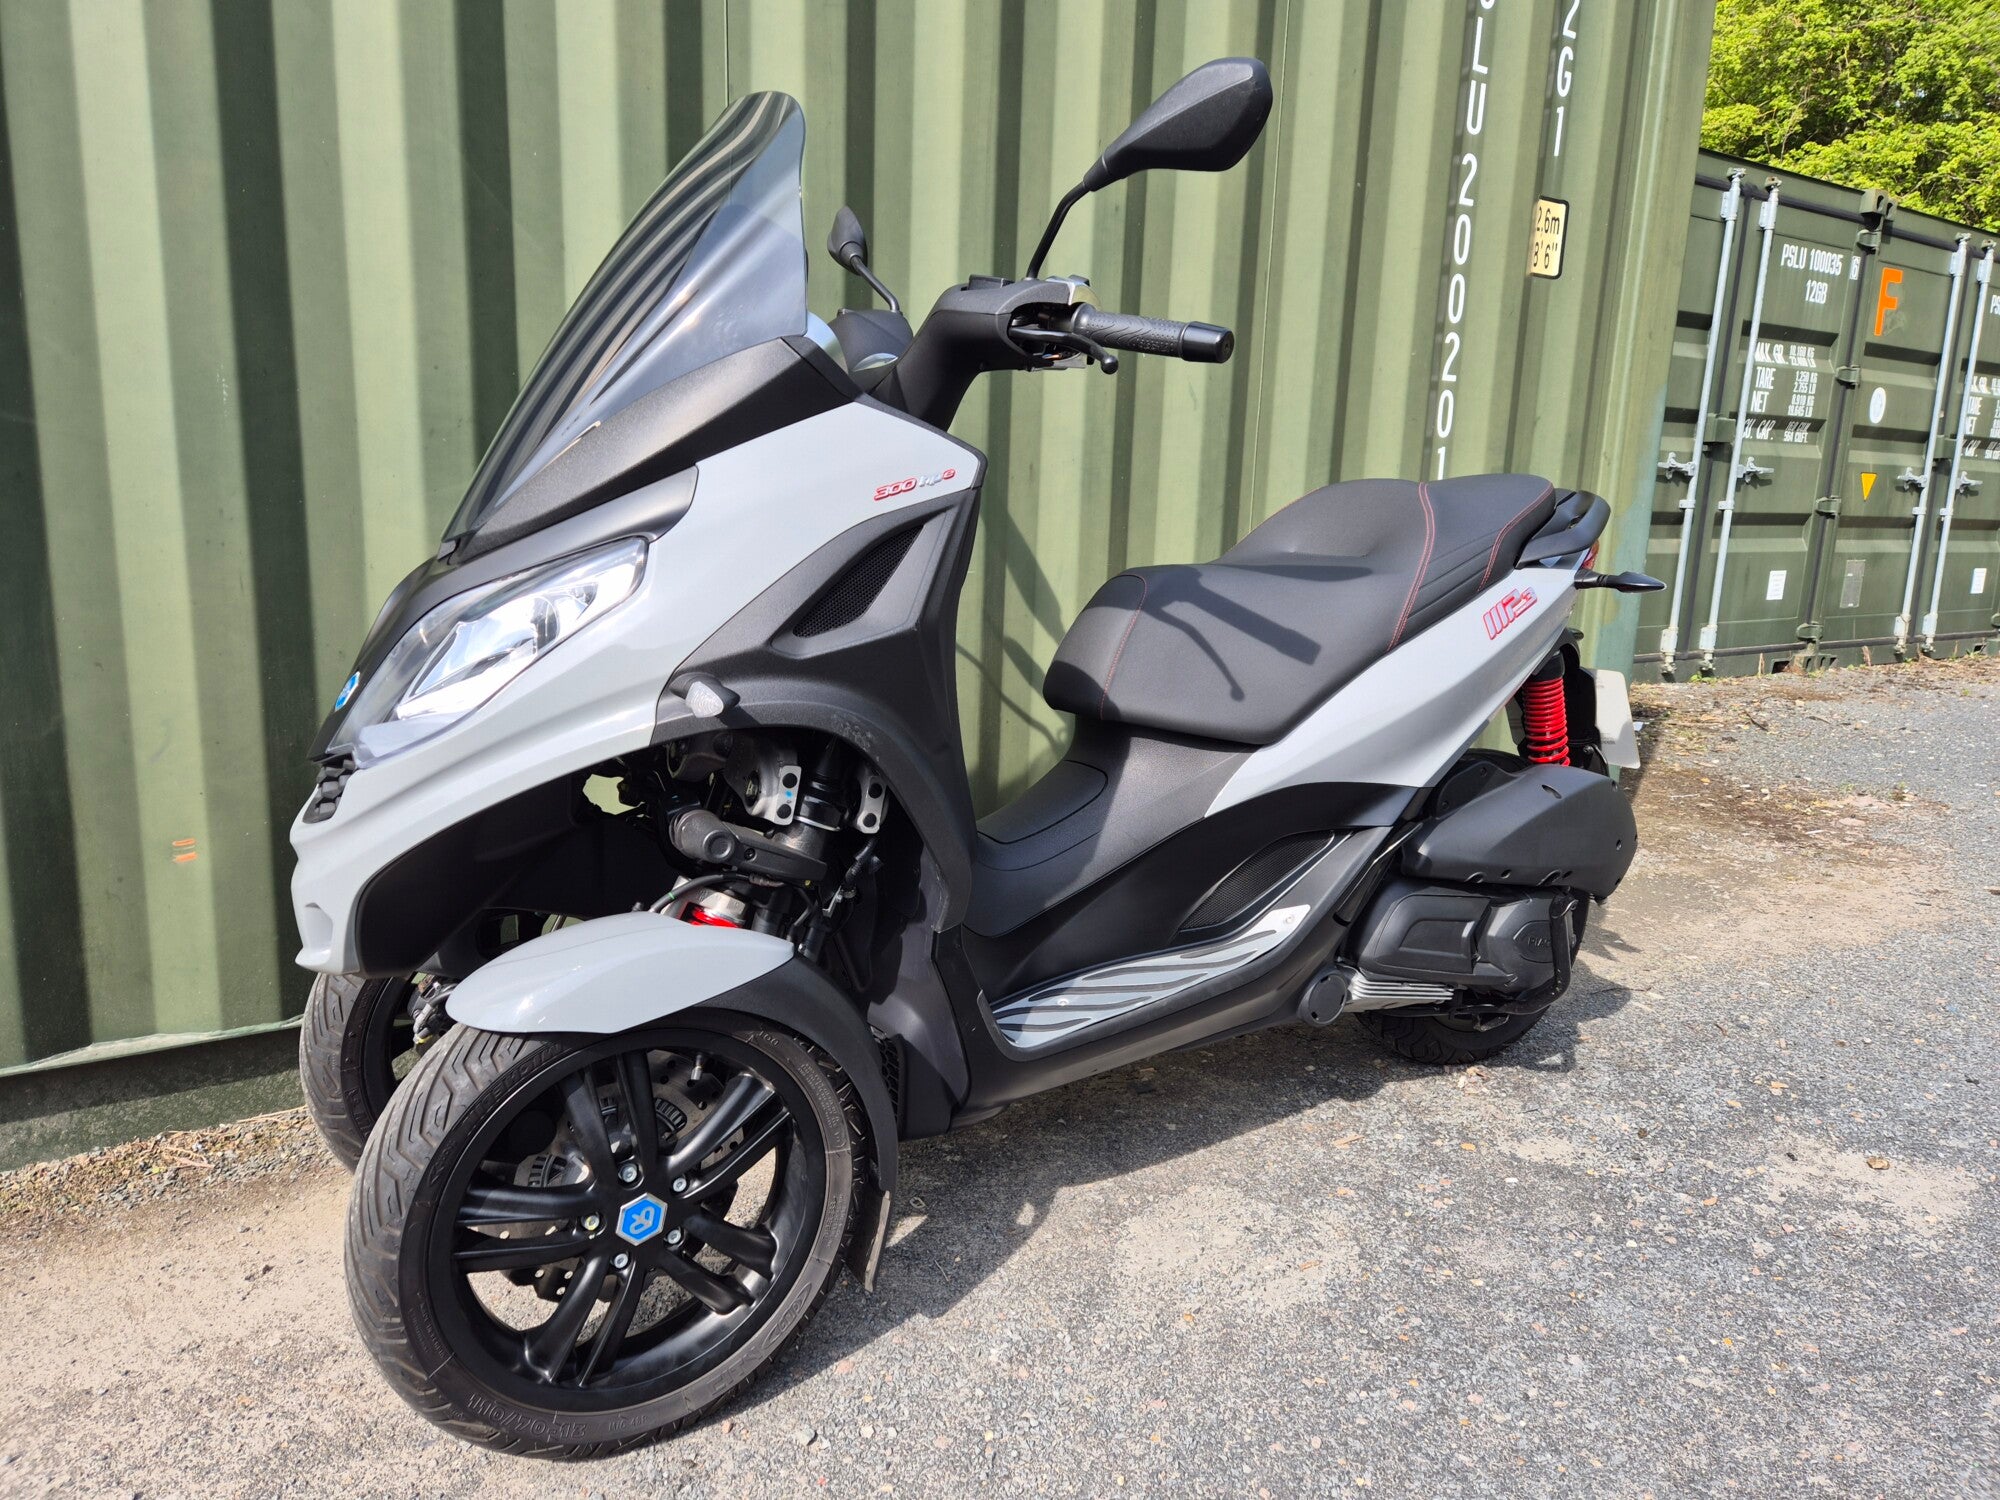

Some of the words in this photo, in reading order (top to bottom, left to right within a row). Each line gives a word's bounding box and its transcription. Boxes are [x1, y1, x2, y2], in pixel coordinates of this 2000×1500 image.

[1467, 0, 1495, 135] LU
[1780, 243, 1808, 270] PSLU
[1809, 247, 1844, 276] 100035
[1874, 267, 1903, 336] F
[1755, 366, 1776, 389] TARE
[1750, 390, 1769, 413] NET
[873, 477, 918, 501] 300
